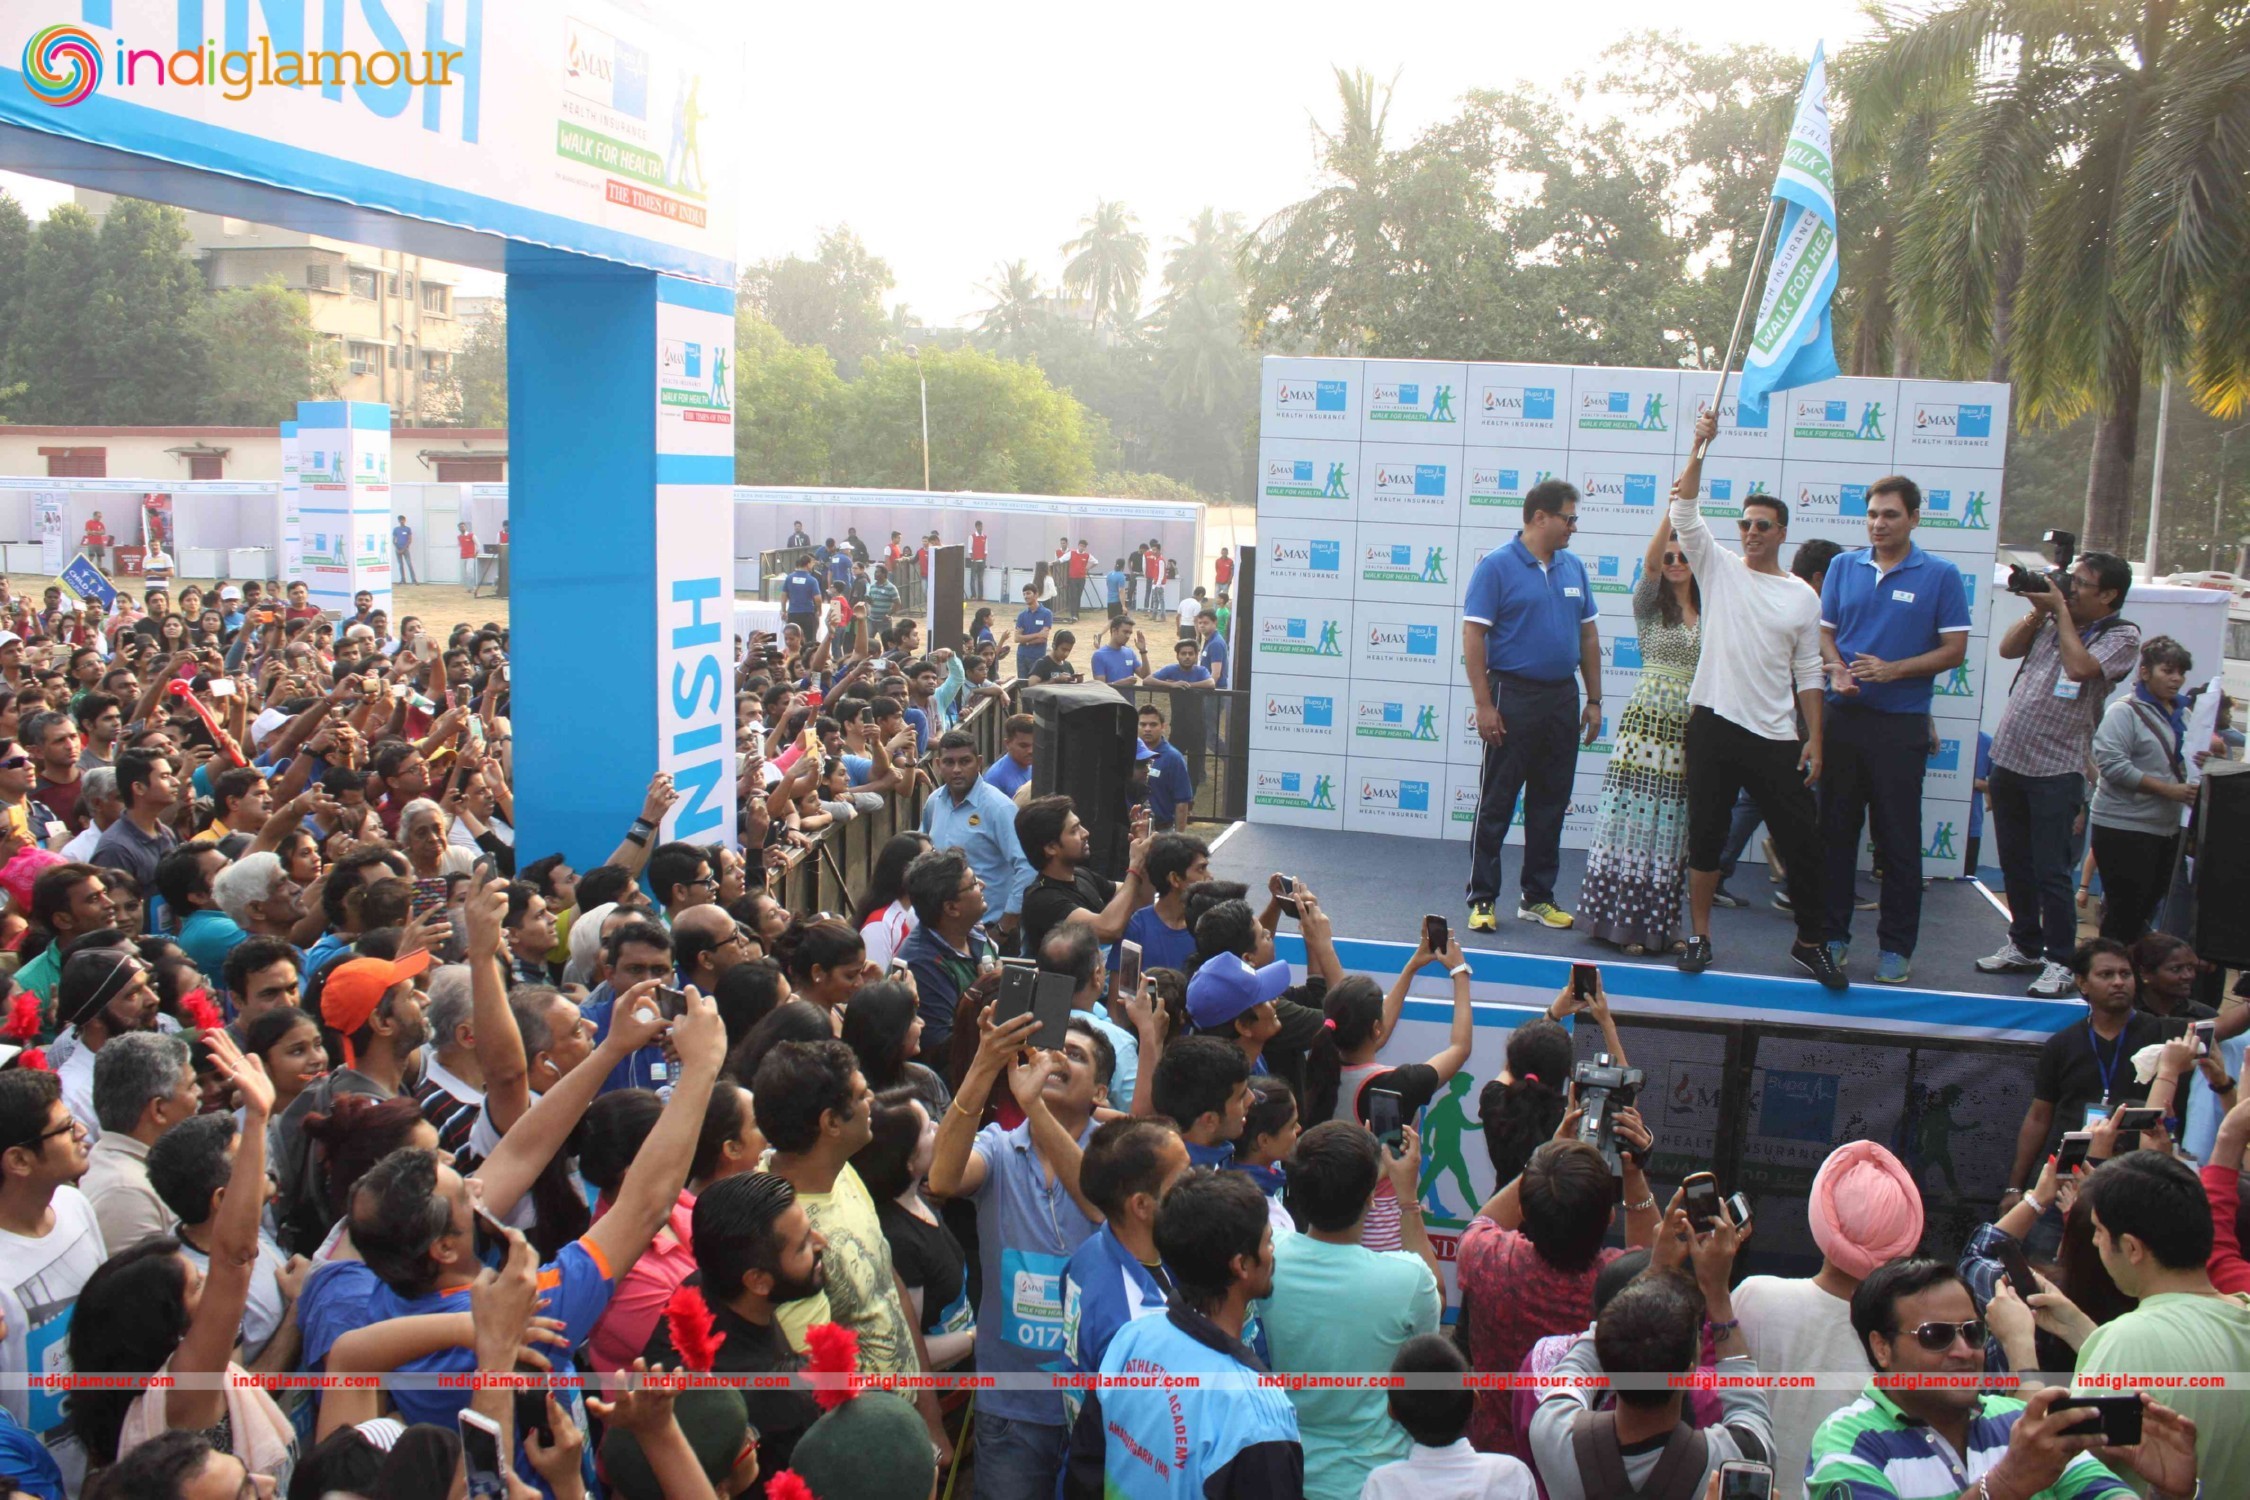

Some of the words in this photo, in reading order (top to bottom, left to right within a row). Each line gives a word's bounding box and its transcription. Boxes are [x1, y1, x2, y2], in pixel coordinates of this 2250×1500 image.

[562, 100, 597, 121] HEALTH
[600, 109, 648, 141] INSURANCE
[1796, 124, 1830, 152] EALT
[560, 129, 594, 158] WALK
[596, 139, 618, 166] FOR
[620, 149, 662, 179] HEALTH
[1819, 169, 1834, 190] FO
[608, 183, 629, 203] THE
[632, 190, 662, 212] TIMES
[664, 200, 677, 217] OF
[679, 204, 705, 225] INDIA
[1759, 288, 1775, 319] ALTH
[1775, 211, 1818, 284] INSURANCE
[1758, 300, 1793, 348] WALK
[1788, 263, 1813, 301] FOR
[1808, 227, 1833, 264] HEA
[1290, 390, 1314, 401] MAX
[1495, 397, 1521, 408] MAX
[1708, 406, 1735, 417] AX
[1927, 415, 1956, 426] MAX
[1944, 439, 1989, 447] INSURANCE
[1388, 474, 1413, 485] MAX
[1596, 483, 1622, 494] MAX
[1810, 494, 1838, 505] MAX
[1283, 549, 1308, 560] MAX
[69, 570, 89, 590] CHILD
[1380, 633, 1405, 644] MAX
[1598, 646, 1612, 657] AX
[672, 576, 723, 846] NISH
[1278, 704, 1302, 715] MAX
[1373, 788, 1397, 799] MAX
[1575, 804, 1598, 815] MAX
[1661, 1134, 1713, 1149] HEALT
[1017, 1304, 1034, 1313] WALK
[1034, 1307, 1047, 1315] FOR
[1048, 1308, 1064, 1316] HEAL
[1168, 1394, 1188, 1470] ACADEMY
